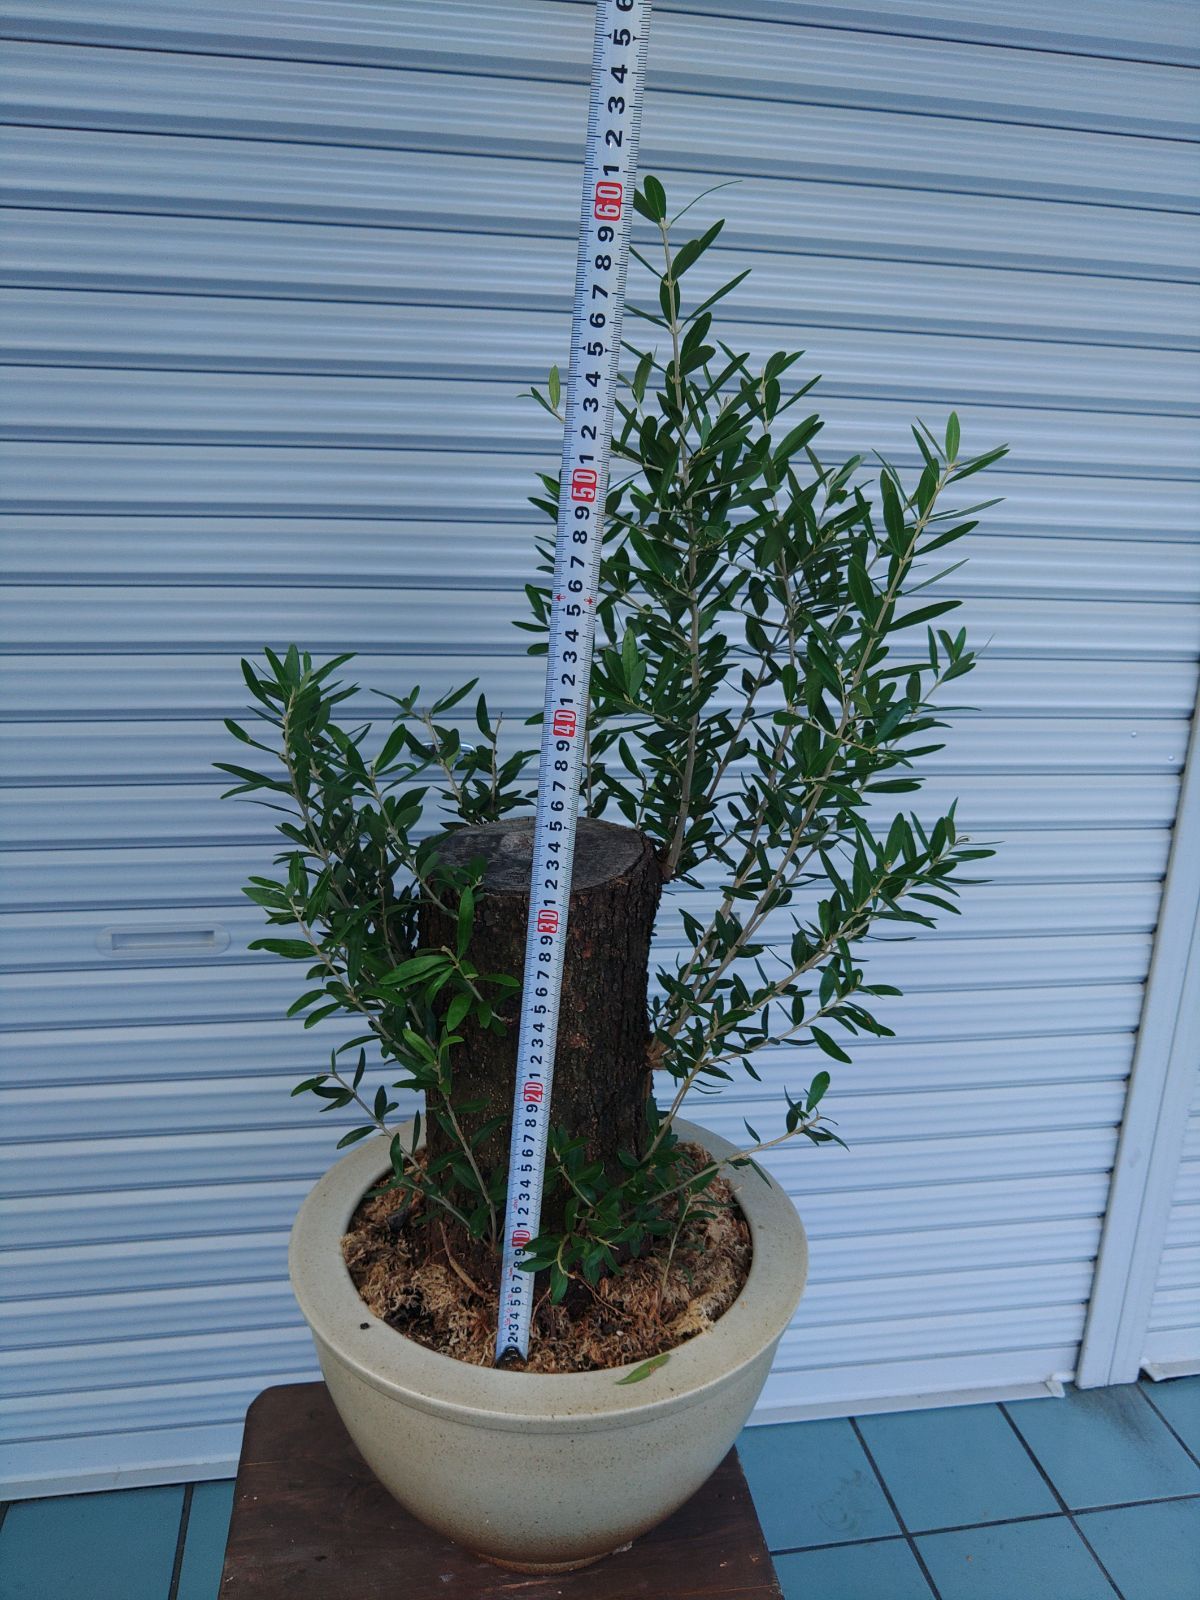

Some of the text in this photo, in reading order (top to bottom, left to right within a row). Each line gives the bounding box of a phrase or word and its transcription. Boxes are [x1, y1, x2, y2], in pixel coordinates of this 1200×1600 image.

[613, 28, 631, 46] 5
[611, 64, 628, 84] 4
[608, 96, 625, 114] 3
[605, 130, 622, 147] 2
[603, 165, 620, 176] 1
[596, 183, 622, 218] 60
[598, 226, 614, 242] 9
[595, 254, 612, 271] 8
[592, 284, 608, 300] 7
[590, 312, 606, 328] 6
[587, 341, 604, 356] 5
[585, 371, 601, 387] 4
[583, 397, 599, 412] 3
[581, 425, 596, 440] 2
[579, 454, 594, 464] 1
[572, 470, 596, 502] 50
[574, 506, 590, 520] 9
[573, 530, 588, 544] 8
[570, 555, 585, 568] 7
[568, 580, 583, 592] 6
[567, 604, 581, 616] 5
[565, 629, 579, 642] 4
[563, 650, 577, 664] 3
[561, 674, 575, 686] 2
[560, 697, 573, 706] 1
[555, 710, 576, 735] 40
[556, 740, 570, 752] 9
[554, 760, 568, 771] 8
[553, 781, 566, 792] 7
[551, 801, 564, 812] 6
[549, 821, 563, 832] 5
[548, 842, 561, 853] 4
[546, 860, 559, 871] 3
[545, 879, 558, 890] 2
[538, 910, 558, 932] 30
[540, 935, 553, 945] 9
[539, 952, 552, 962] 8
[537, 970, 550, 980] 7
[535, 987, 548, 997] 6
[534, 1005, 547, 1014] 5
[533, 1022, 545, 1033] 4
[531, 1039, 544, 1048] 3
[530, 1055, 542, 1064] 2
[524, 1083, 543, 1102] 20
[526, 1104, 538, 1113] 9
[525, 1119, 537, 1128] 8
[523, 1134, 535, 1143] 7
[522, 1149, 534, 1157] 6
[521, 1164, 532, 1172] 5
[520, 1179, 532, 1188] 4
[519, 1193, 530, 1201] 3
[517, 1207, 529, 1215] 2
[512, 1274, 523, 1282] 7
